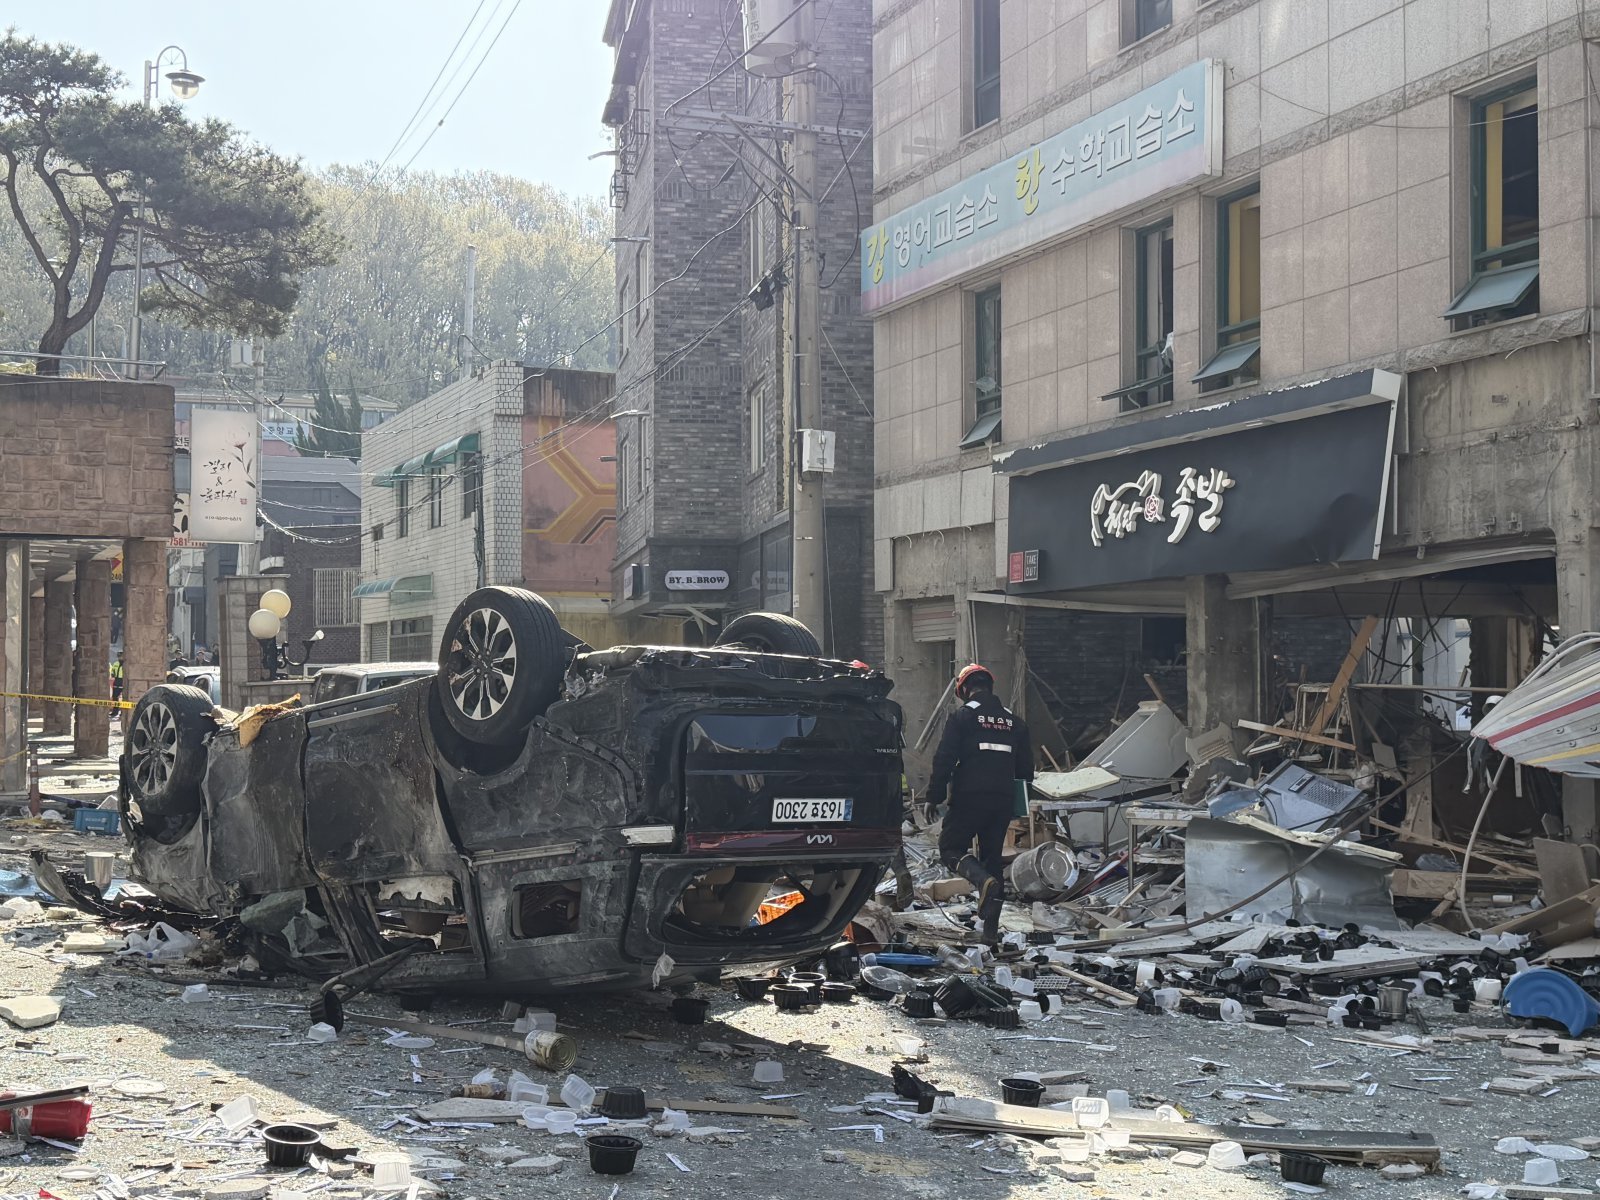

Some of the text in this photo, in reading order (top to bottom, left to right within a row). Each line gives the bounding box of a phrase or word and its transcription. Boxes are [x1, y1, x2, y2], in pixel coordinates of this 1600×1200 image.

[867, 225, 890, 285] 강
[894, 184, 999, 268] 영어교습소
[1015, 148, 1045, 216] 한
[1052, 87, 1196, 195] 수학교습소
[1167, 467, 1236, 544] 족발
[1026, 555, 1037, 565] TAKE
[1026, 567, 1037, 577] OUT
[776, 801, 842, 819] 163호 2300
